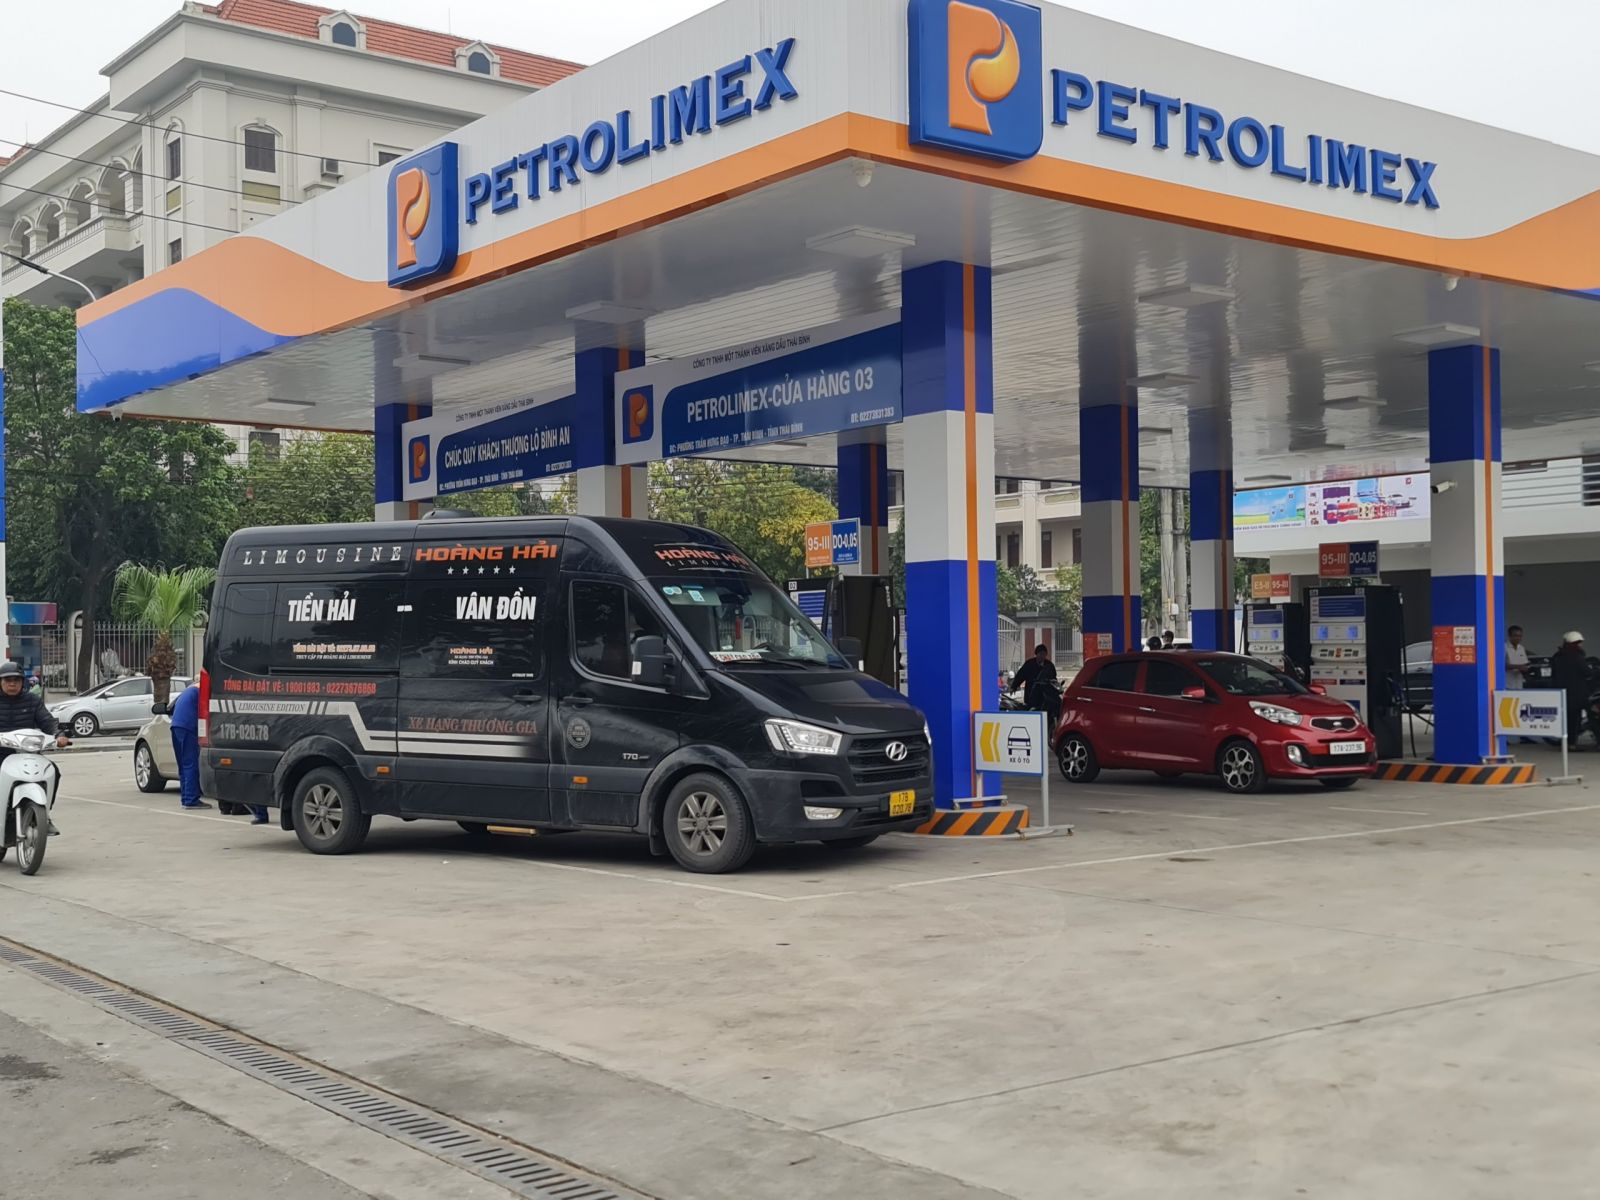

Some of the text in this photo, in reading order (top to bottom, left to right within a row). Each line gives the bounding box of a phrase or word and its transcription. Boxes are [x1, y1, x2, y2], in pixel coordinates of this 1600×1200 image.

[465, 38, 799, 225] PETROLIMEX
[1051, 68, 1440, 210] PETROLIMEX
[807, 369, 850, 401] HÀNG
[854, 366, 874, 392] 03
[444, 425, 570, 468] CHÚC QUÝ KHÁCH THƯỢNG LỘ BÌNH AN
[808, 536, 830, 551] 95-III
[833, 532, 857, 550] DO-0,05
[243, 546, 402, 565] LIMOUSINE
[416, 540, 558, 561] HOÀNG HẢI
[654, 546, 720, 560] HOÀNG
[1322, 553, 1346, 565] 95-III
[1350, 552, 1376, 565] DO-0,05
[288, 592, 324, 622] TIỀN
[326, 590, 356, 621] HẢI
[456, 592, 492, 620] VÂN
[496, 586, 536, 620] ĐỒN
[238, 702, 306, 712] LIMOUSINE EDITION
[408, 716, 424, 730] XE
[425, 718, 459, 732] HẠNG
[515, 720, 538, 734] GIA
